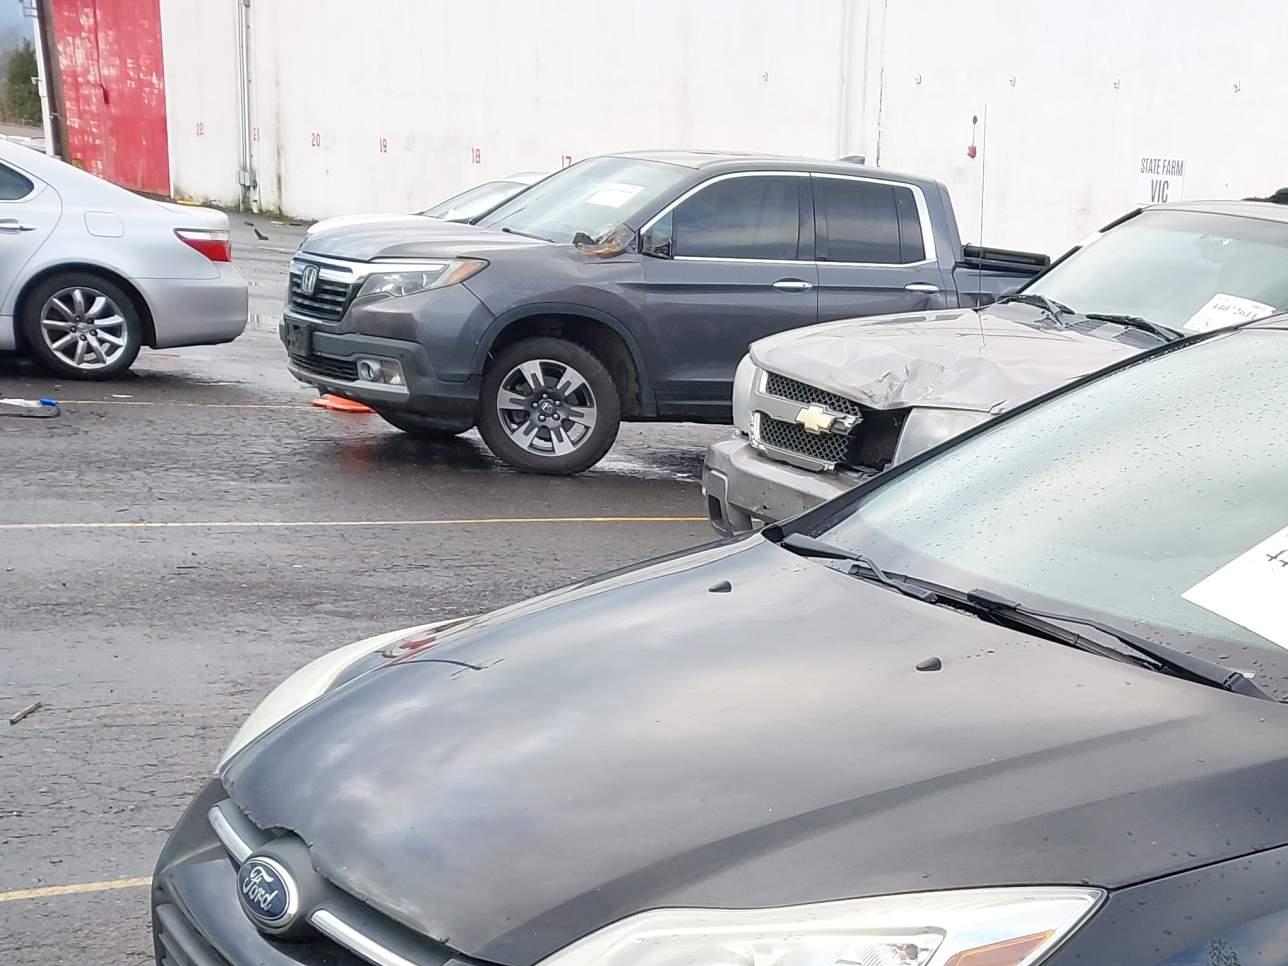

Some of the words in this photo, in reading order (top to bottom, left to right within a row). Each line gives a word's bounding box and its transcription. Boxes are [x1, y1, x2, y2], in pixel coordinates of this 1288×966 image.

[311, 132, 321, 147] 20
[379, 138, 388, 153] 19
[471, 148, 481, 164] 18
[1140, 157, 1161, 175] STATE
[1162, 159, 1184, 177] FARM
[1151, 179, 1169, 203] VIC
[242, 865, 278, 911] Ford
